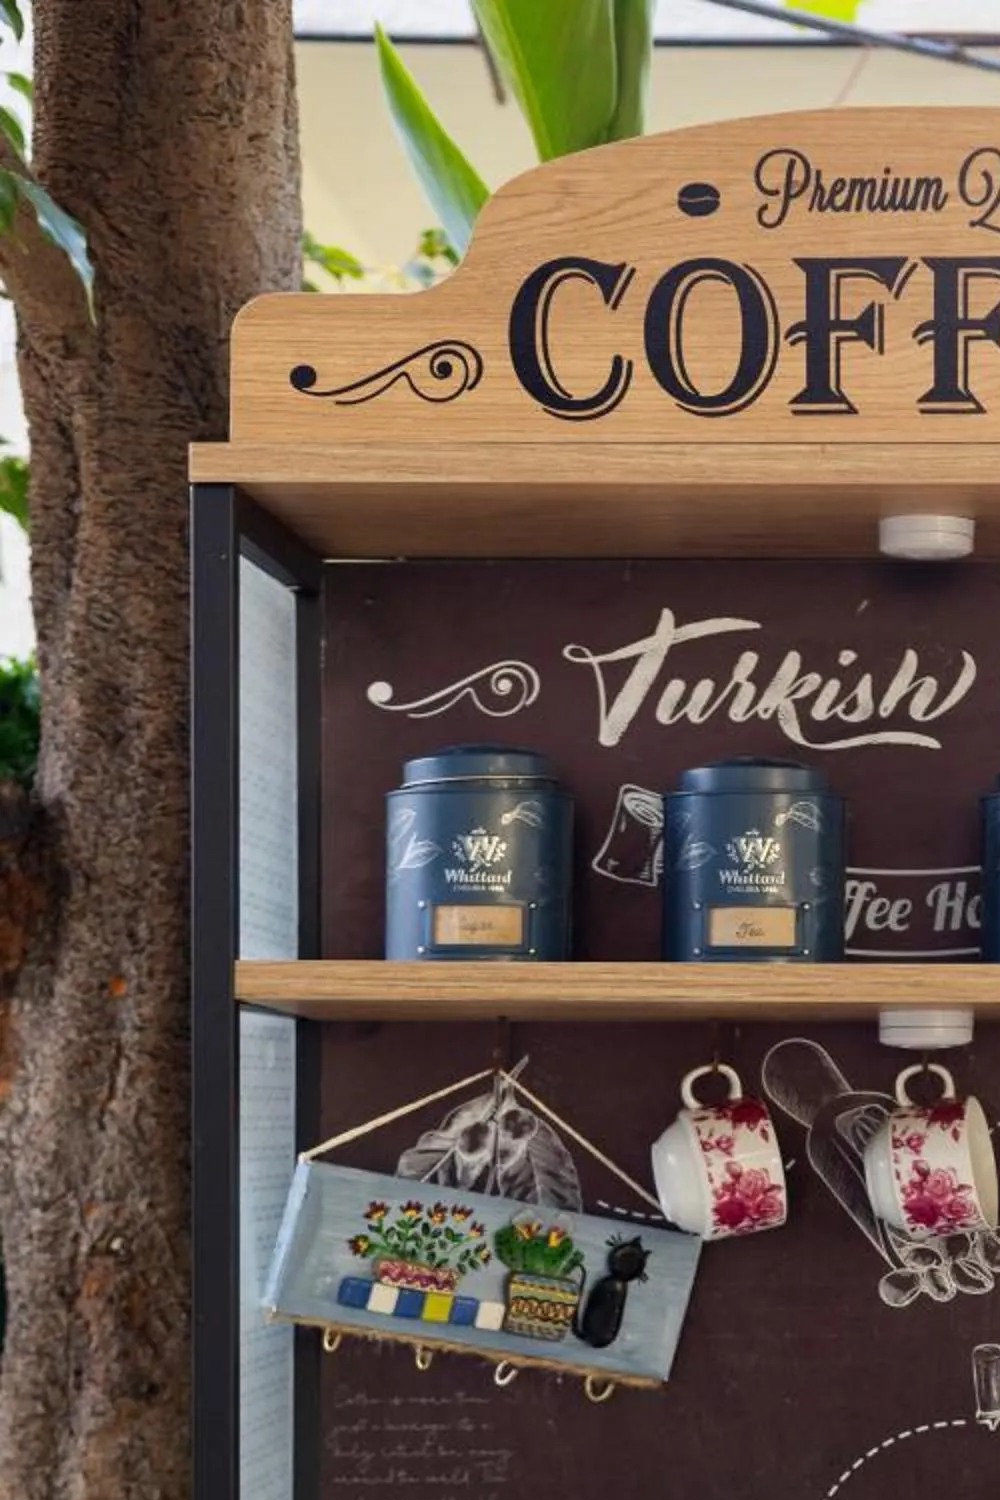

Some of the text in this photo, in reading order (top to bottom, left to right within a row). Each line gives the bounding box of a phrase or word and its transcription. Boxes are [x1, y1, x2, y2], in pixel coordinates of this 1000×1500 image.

[754, 148, 949, 230] Premium
[563, 608, 977, 751] Turkish
[444, 868, 513, 886] Whittard
[718, 869, 786, 886] Whittard
